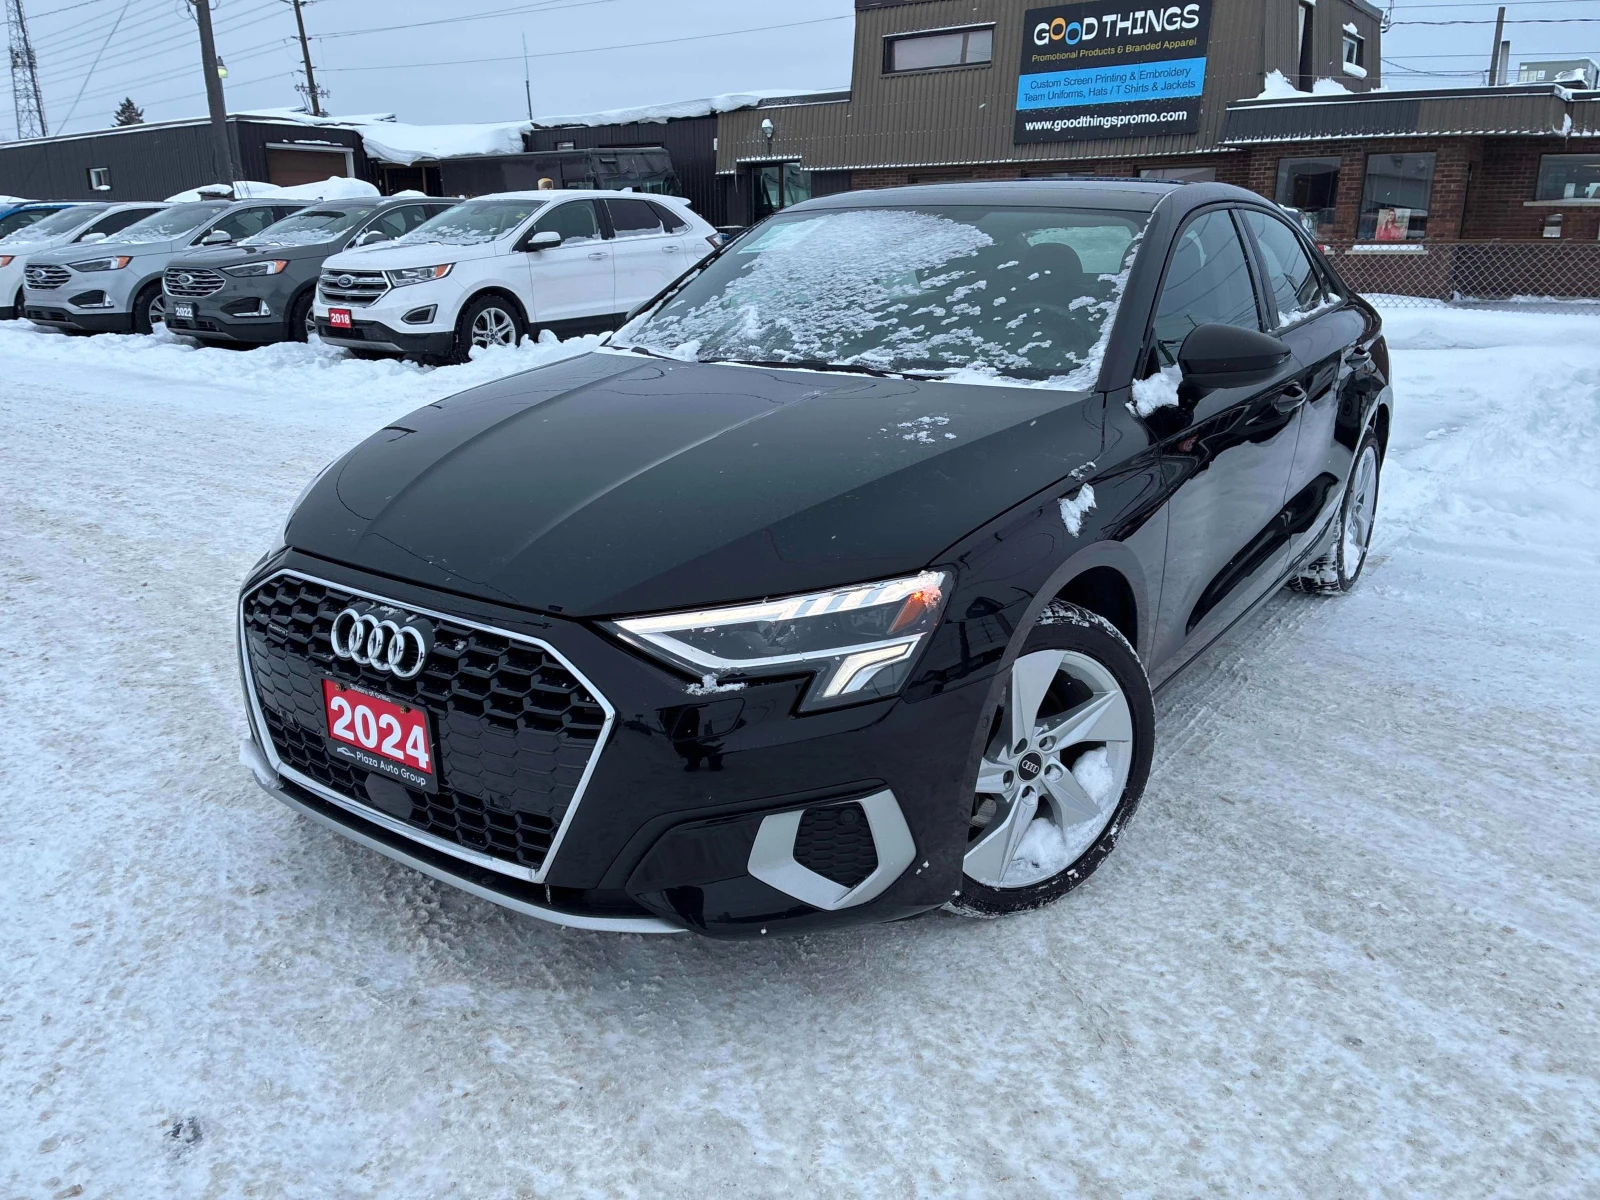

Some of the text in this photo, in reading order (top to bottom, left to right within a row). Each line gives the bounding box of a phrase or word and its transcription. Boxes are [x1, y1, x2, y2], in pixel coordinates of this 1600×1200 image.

[1033, 3, 1200, 46] GOOD THINGS
[1031, 37, 1197, 62] Promotional Products & Branded Apparel
[1024, 93, 1045, 102] Team
[1047, 90, 1086, 100] Uniforms,
[1088, 87, 1108, 97] Hats
[1116, 85, 1122, 95] T
[1124, 83, 1149, 94] Shirts
[1151, 82, 1158, 92] &
[1161, 79, 1196, 91] Jackets
[1030, 68, 1191, 90] Custom Screen Printing & Embroidery
[1025, 110, 1188, 132] www.goodthingspromo.com
[175, 307, 193, 317] 2022
[330, 313, 350, 324] 2018
[330, 695, 429, 769] 2024
[356, 751, 426, 787] Plaza Auto Group
